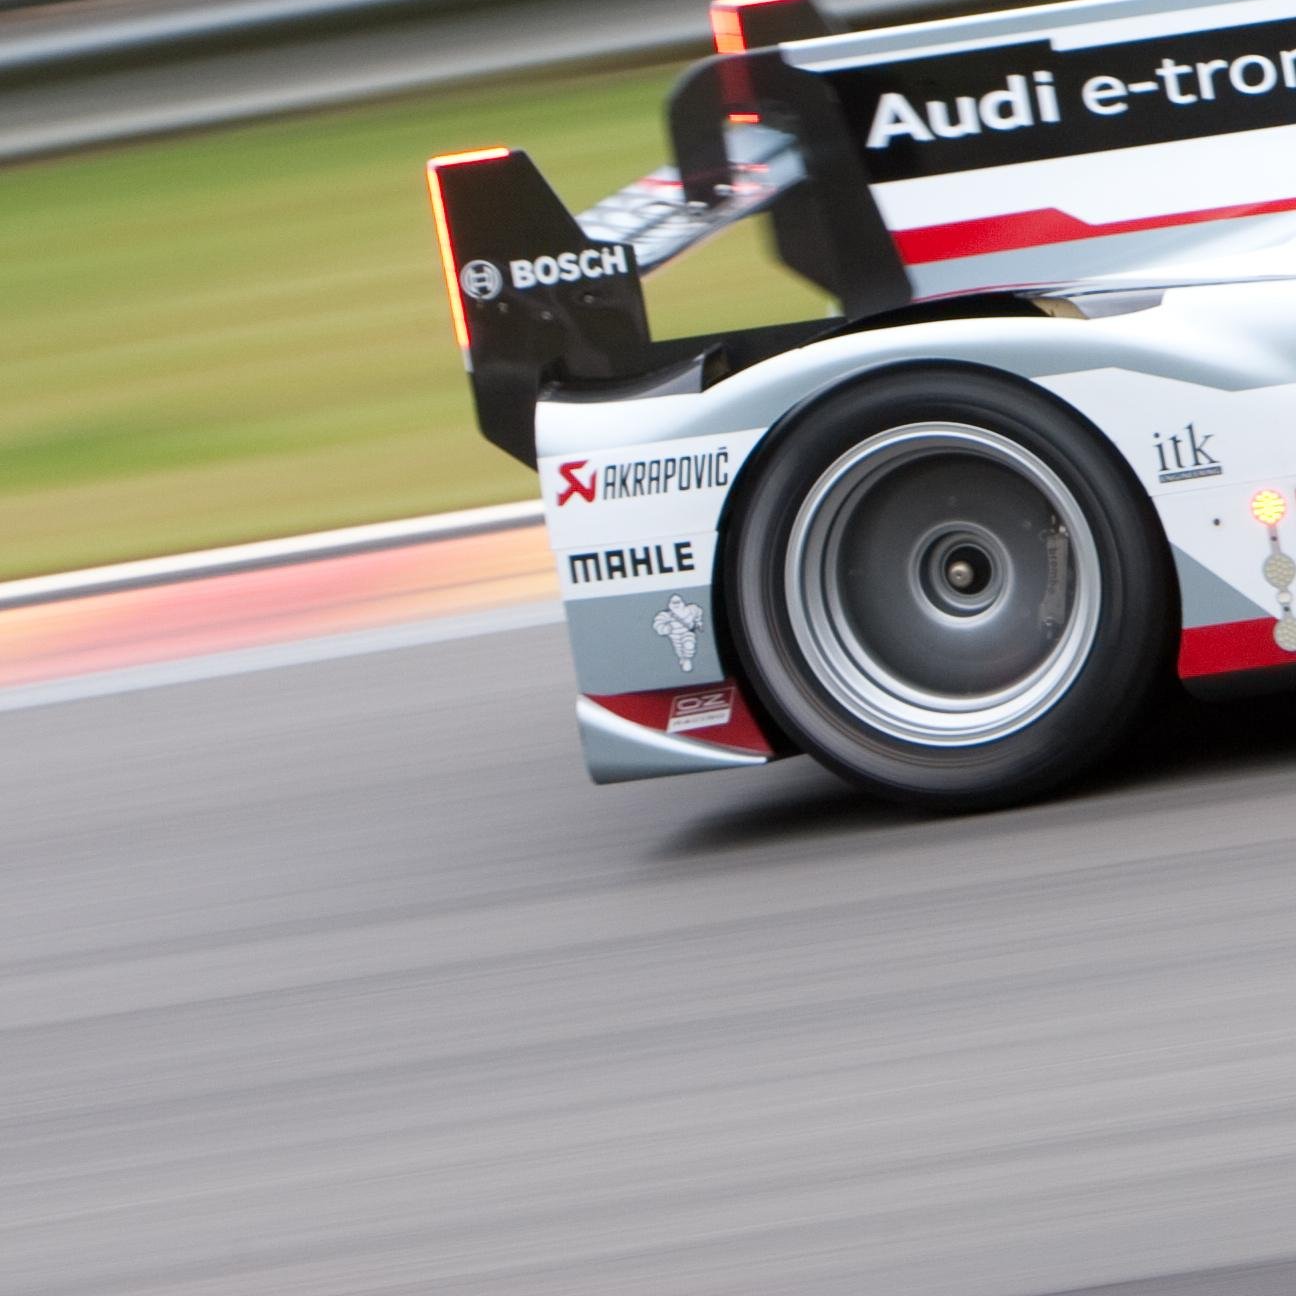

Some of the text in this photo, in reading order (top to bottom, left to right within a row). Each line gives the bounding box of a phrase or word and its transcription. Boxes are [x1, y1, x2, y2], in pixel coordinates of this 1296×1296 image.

[865, 70, 1061, 150] Audi
[509, 244, 628, 289] BOSCH
[1153, 422, 1220, 471] itk
[603, 446, 728, 500] AKRAPOVIČ
[569, 541, 695, 584] MAHLE
[676, 692, 728, 711] OZ
